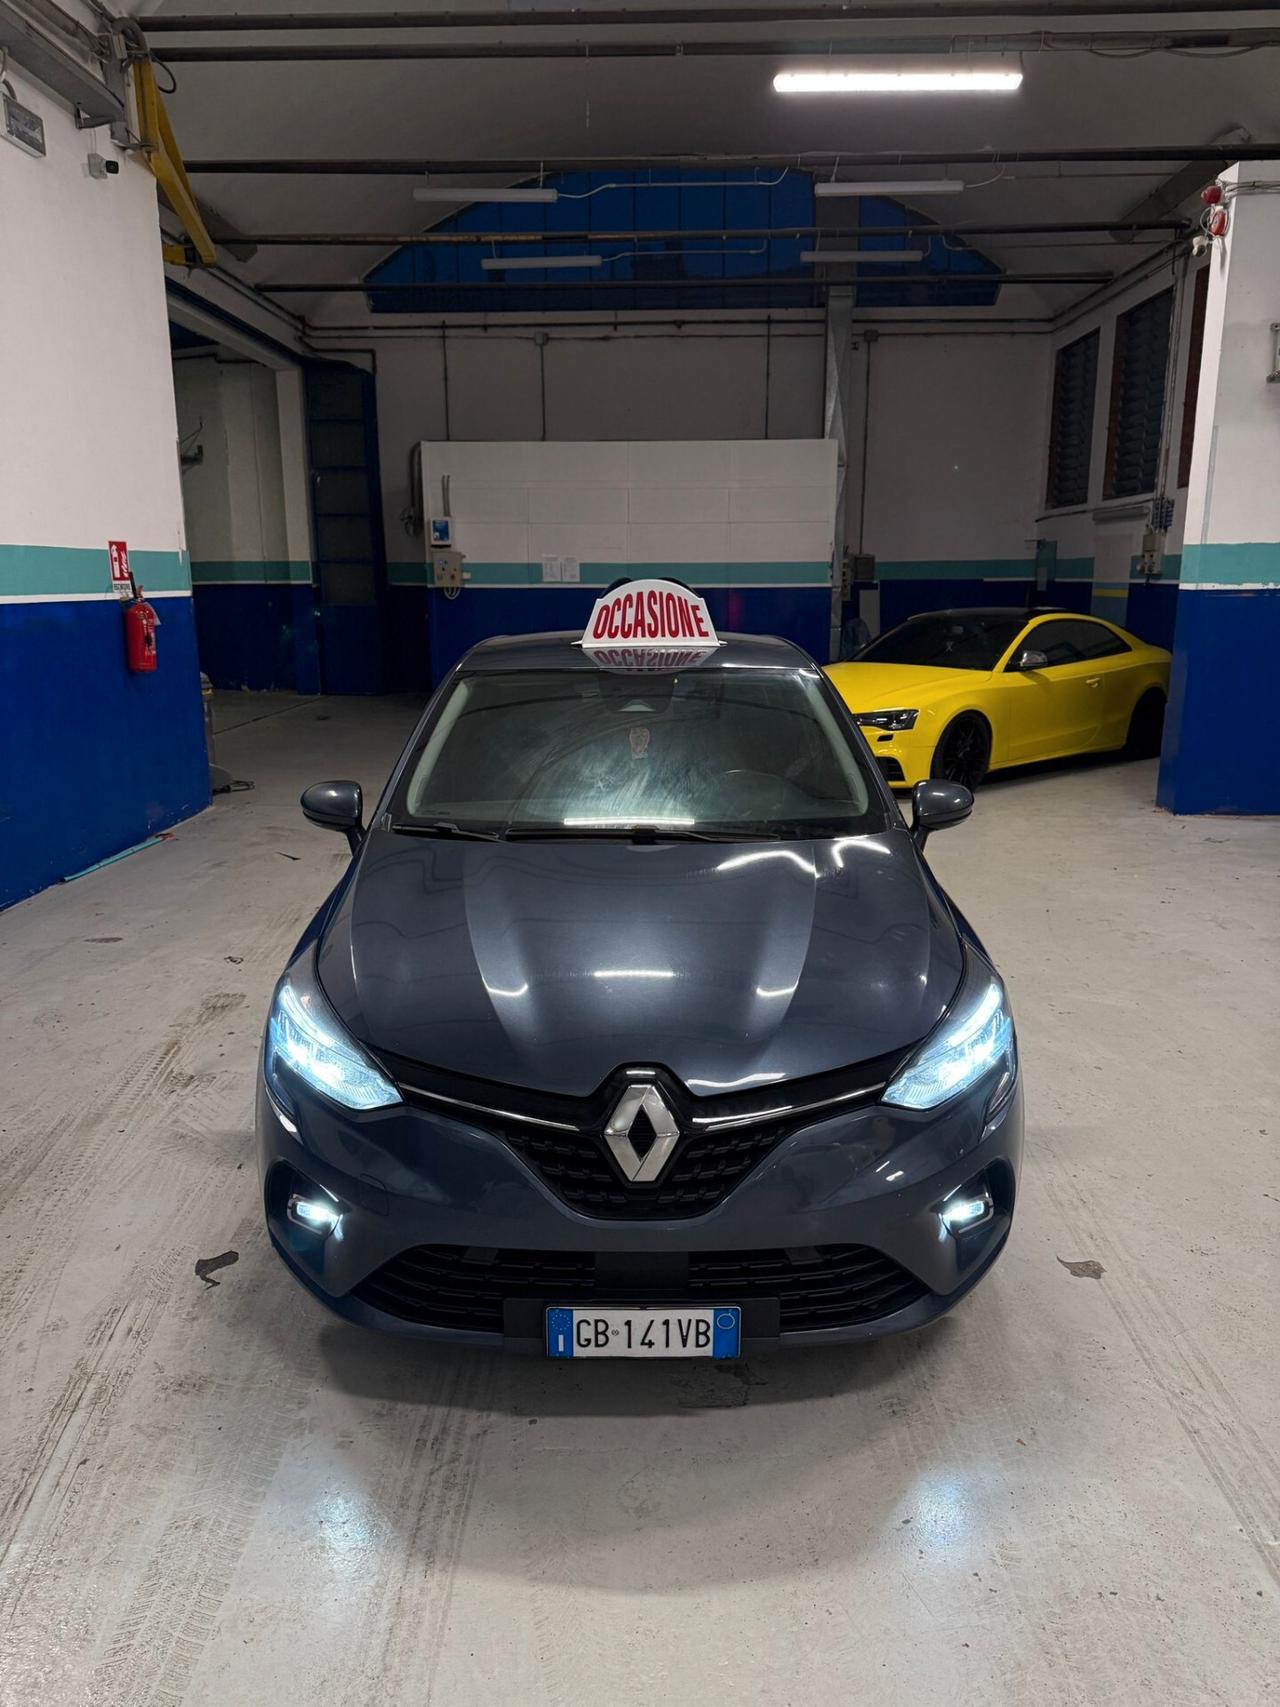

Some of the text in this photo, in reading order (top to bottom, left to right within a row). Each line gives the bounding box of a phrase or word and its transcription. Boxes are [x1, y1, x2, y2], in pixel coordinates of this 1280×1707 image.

[593, 590, 709, 639] OCCASIONE
[576, 1319, 711, 1348] GB 141VB
